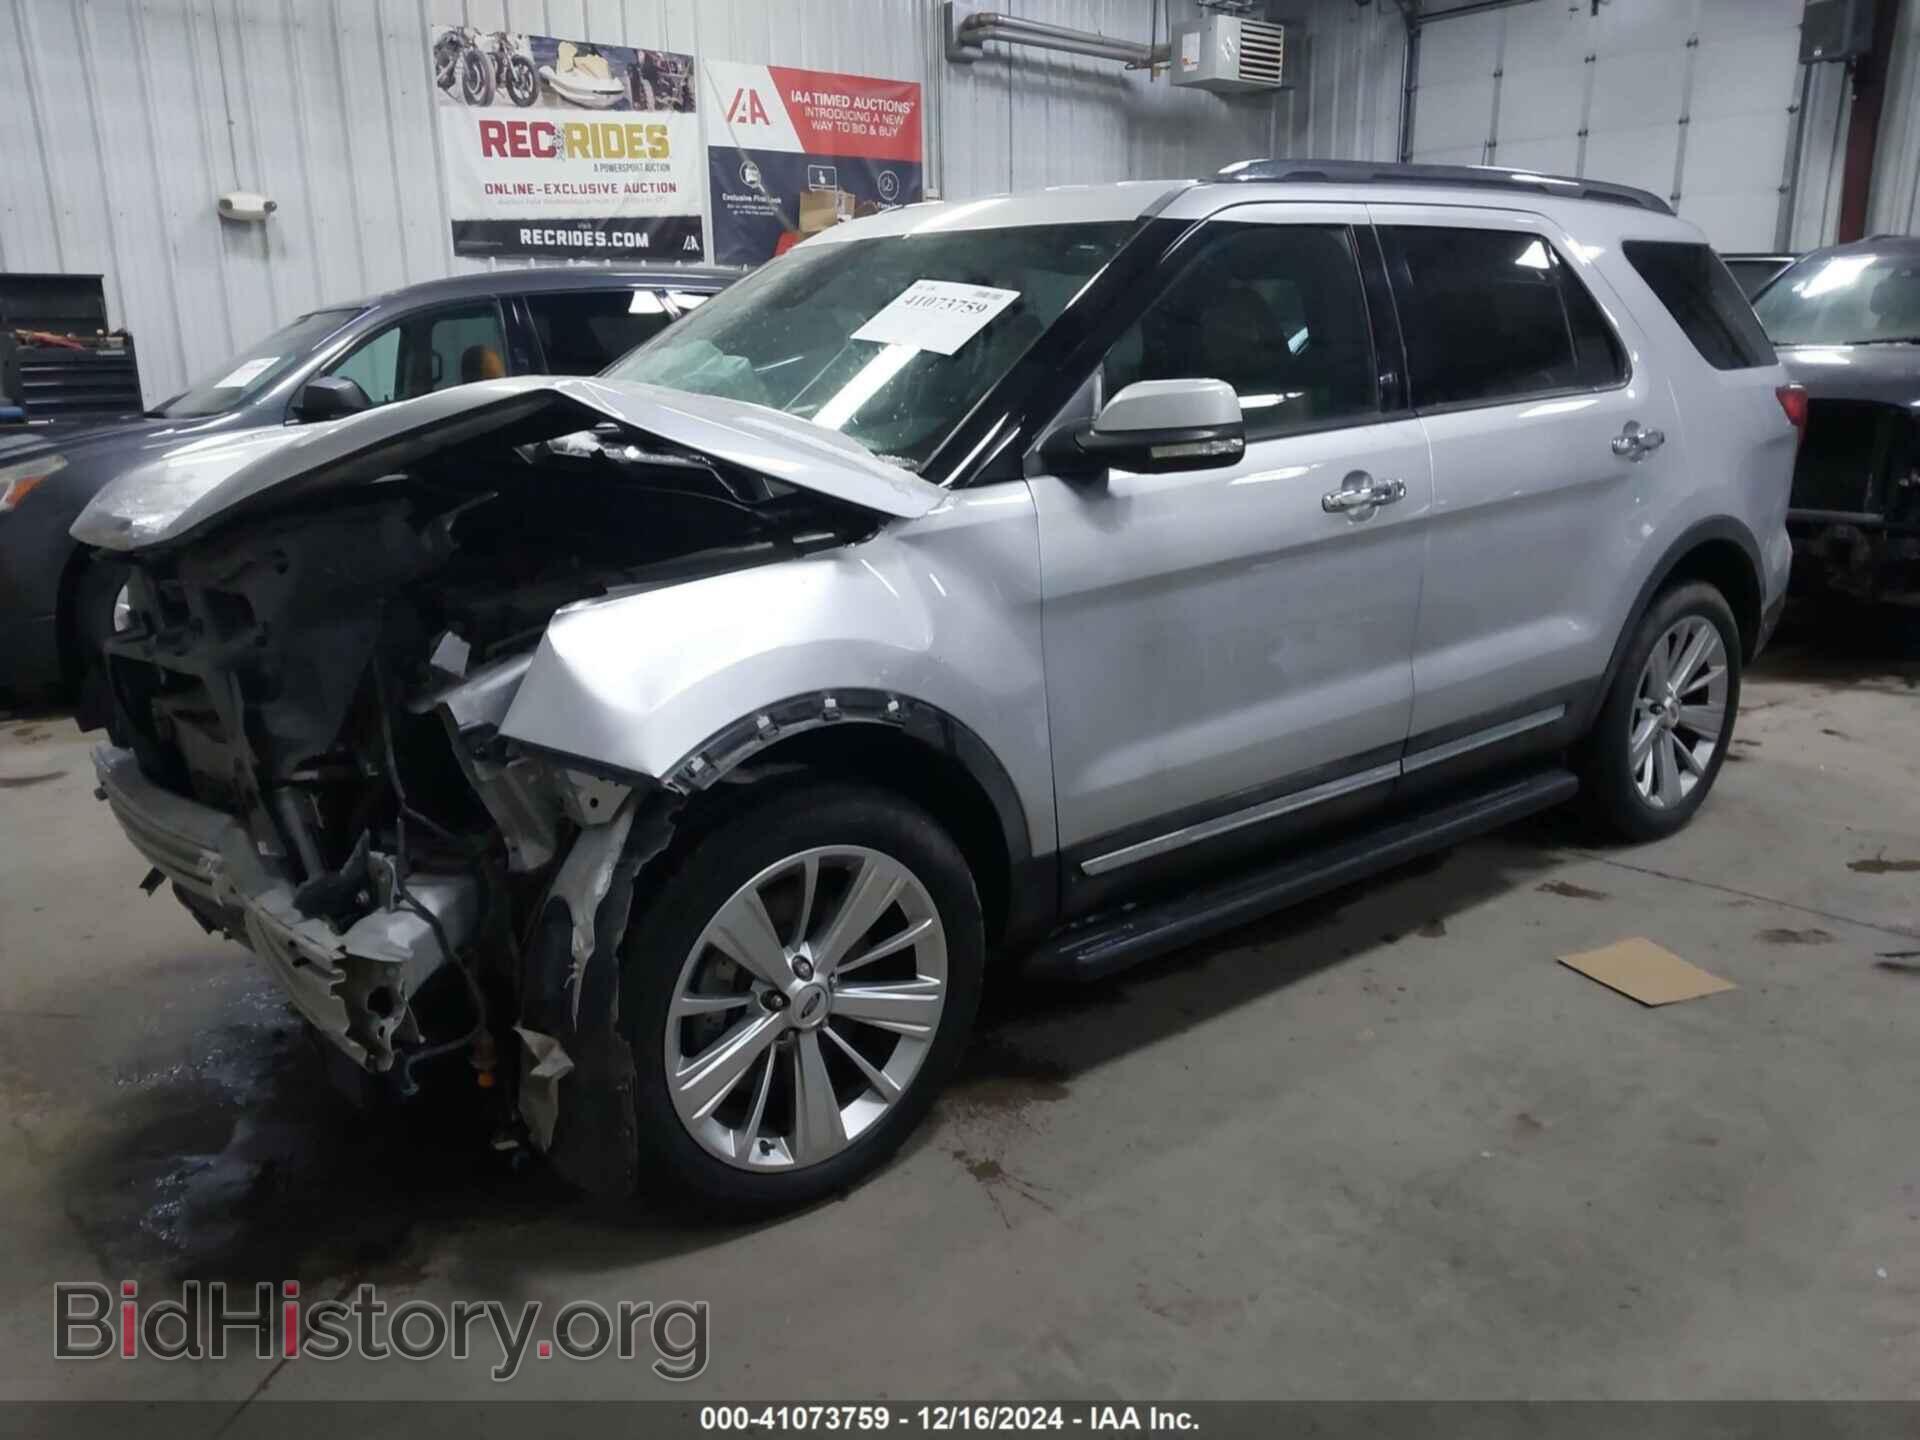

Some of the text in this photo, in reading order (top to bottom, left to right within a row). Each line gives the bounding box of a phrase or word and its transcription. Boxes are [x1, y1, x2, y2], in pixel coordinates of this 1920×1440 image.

[791, 90, 811, 104] IAA
[812, 93, 850, 108] TIMED
[805, 107, 905, 125] INTRODUCING A NEW
[811, 120, 833, 131] WAY
[835, 122, 850, 133] TO
[852, 123, 866, 134] BID
[879, 126, 899, 137] BUY
[479, 120, 671, 159] REC RIDES
[645, 163, 671, 172] AUCTION
[485, 182, 677, 195] ONLINE-EXCLUSIVE AUCTION
[520, 228, 650, 248] RECRIDES.COM
[904, 295, 989, 313] 41073759
